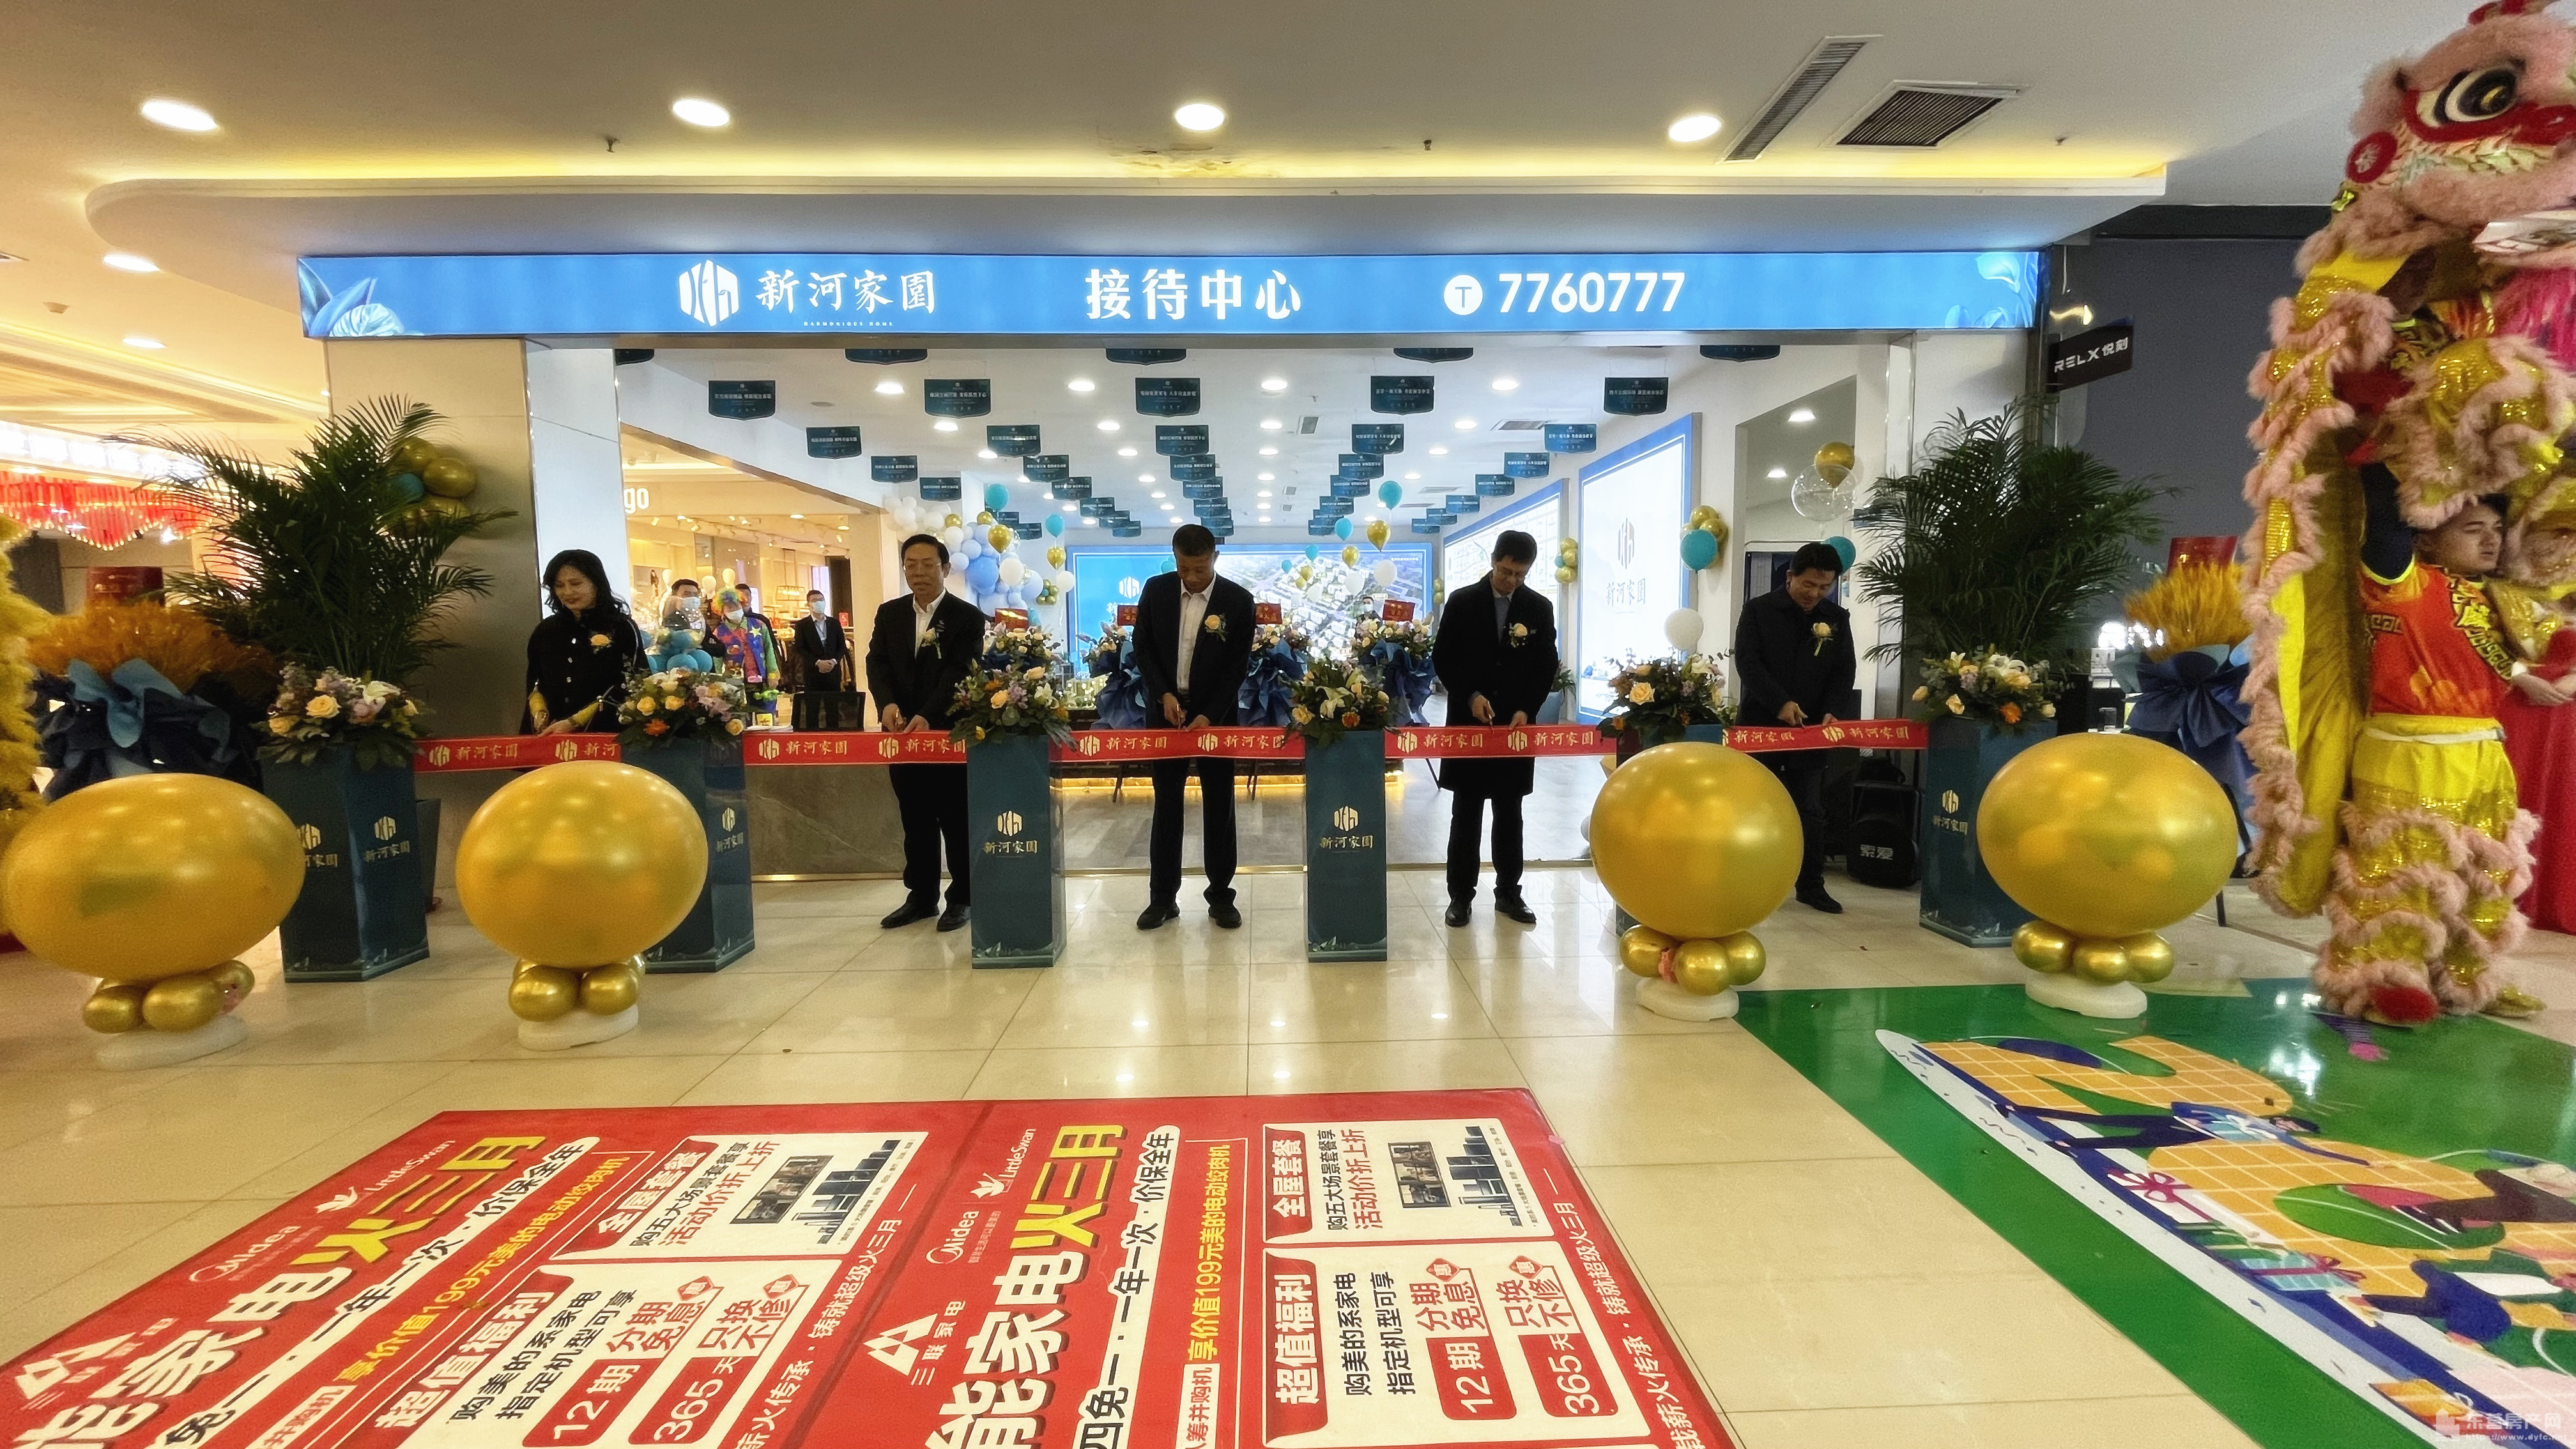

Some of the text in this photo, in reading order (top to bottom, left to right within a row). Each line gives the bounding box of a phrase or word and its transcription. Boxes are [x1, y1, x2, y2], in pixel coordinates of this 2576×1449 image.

[1085, 268, 1301, 320] 接待中心
[1499, 272, 1685, 313] 7760777
[2054, 346, 2100, 372] RELX
[1860, 844, 1894, 861] 索爱
[999, 1128, 1036, 1179] LittleSwan
[1271, 1138, 1307, 1218] 全屋套餐
[1317, 1128, 1349, 1230] 购五大场景套餐享
[1340, 1129, 1384, 1230] 活动价折上折
[598, 1151, 707, 1234] 全屋套餐
[658, 1140, 781, 1245] 活动价折上折
[926, 1211, 980, 1264] Midea
[1187, 1144, 1230, 1361] 享价值199元美的电动绞肉机
[606, 1301, 673, 1353] 分期
[640, 1300, 706, 1353] 免息
[696, 1299, 763, 1351] 只换
[731, 1298, 792, 1350] 不修
[1409, 1282, 1450, 1331] 分期
[1443, 1280, 1486, 1331] 免息
[1496, 1279, 1542, 1328] 只换
[1528, 1278, 1574, 1327] 不修
[449, 1289, 602, 1420] 购美的系家电
[494, 1289, 638, 1420] 指定机型可享
[910, 1300, 966, 1386] 三联家电
[1274, 1273, 1320, 1405] 超值福利
[1333, 1272, 1373, 1396] 购美的系家电
[1369, 1271, 1416, 1395] 指定机型可享
[375, 1292, 555, 1428] 超值福利
